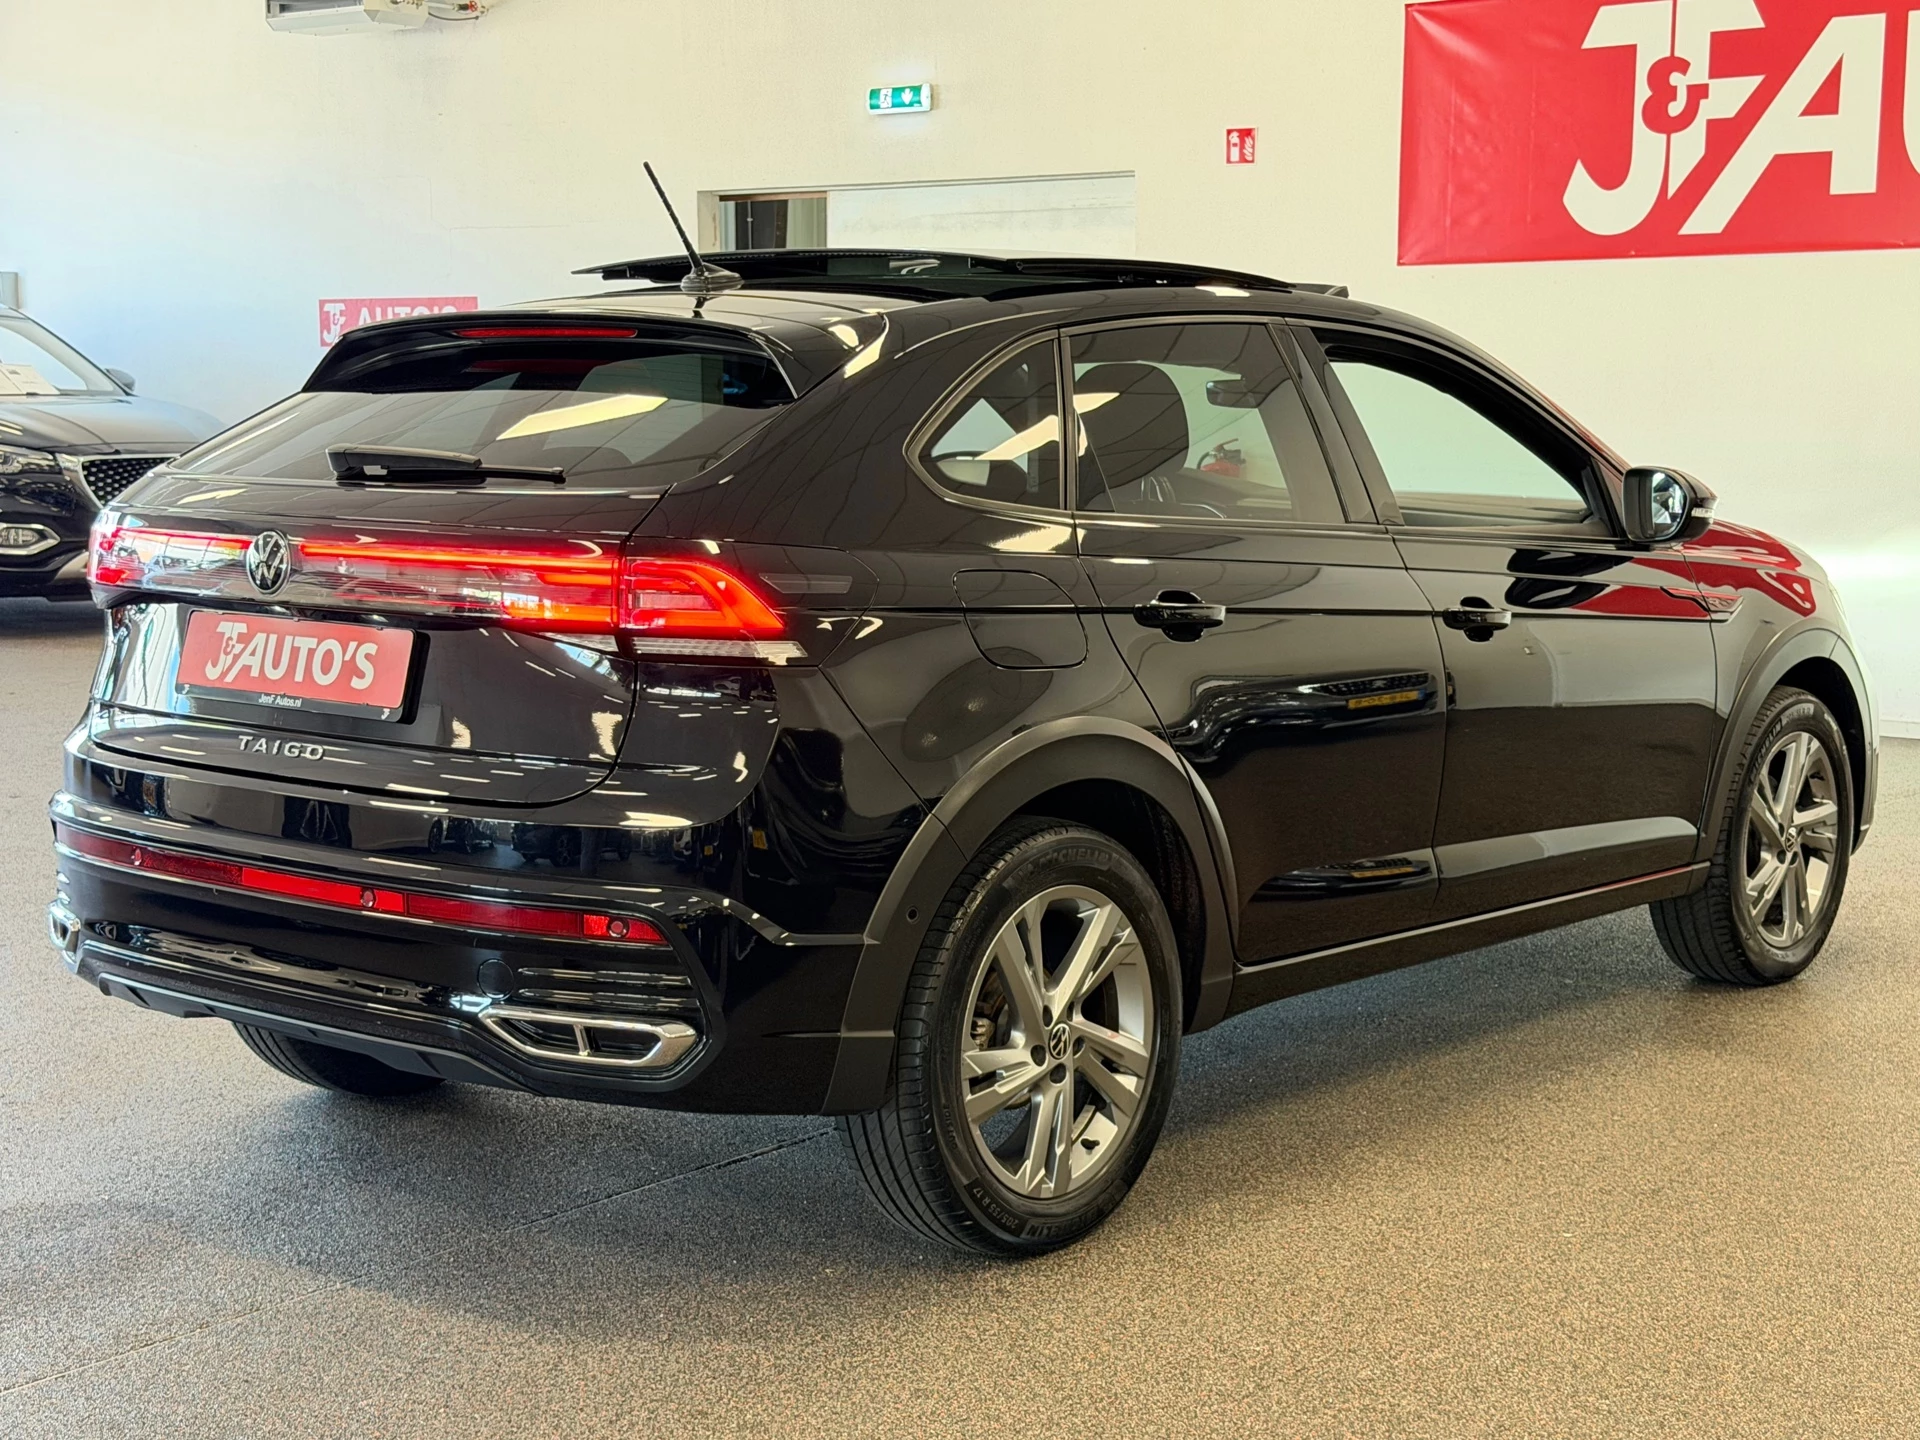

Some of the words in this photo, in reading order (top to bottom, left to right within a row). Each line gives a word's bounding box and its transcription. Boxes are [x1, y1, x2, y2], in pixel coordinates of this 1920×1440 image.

[224, 633, 378, 690] AUTO'S
[275, 695, 302, 707] Autos.nl
[238, 735, 324, 761] TAIGO
[973, 1187, 984, 1198] 17
[982, 1197, 991, 1207] R
[989, 1203, 1019, 1229] 205/55
